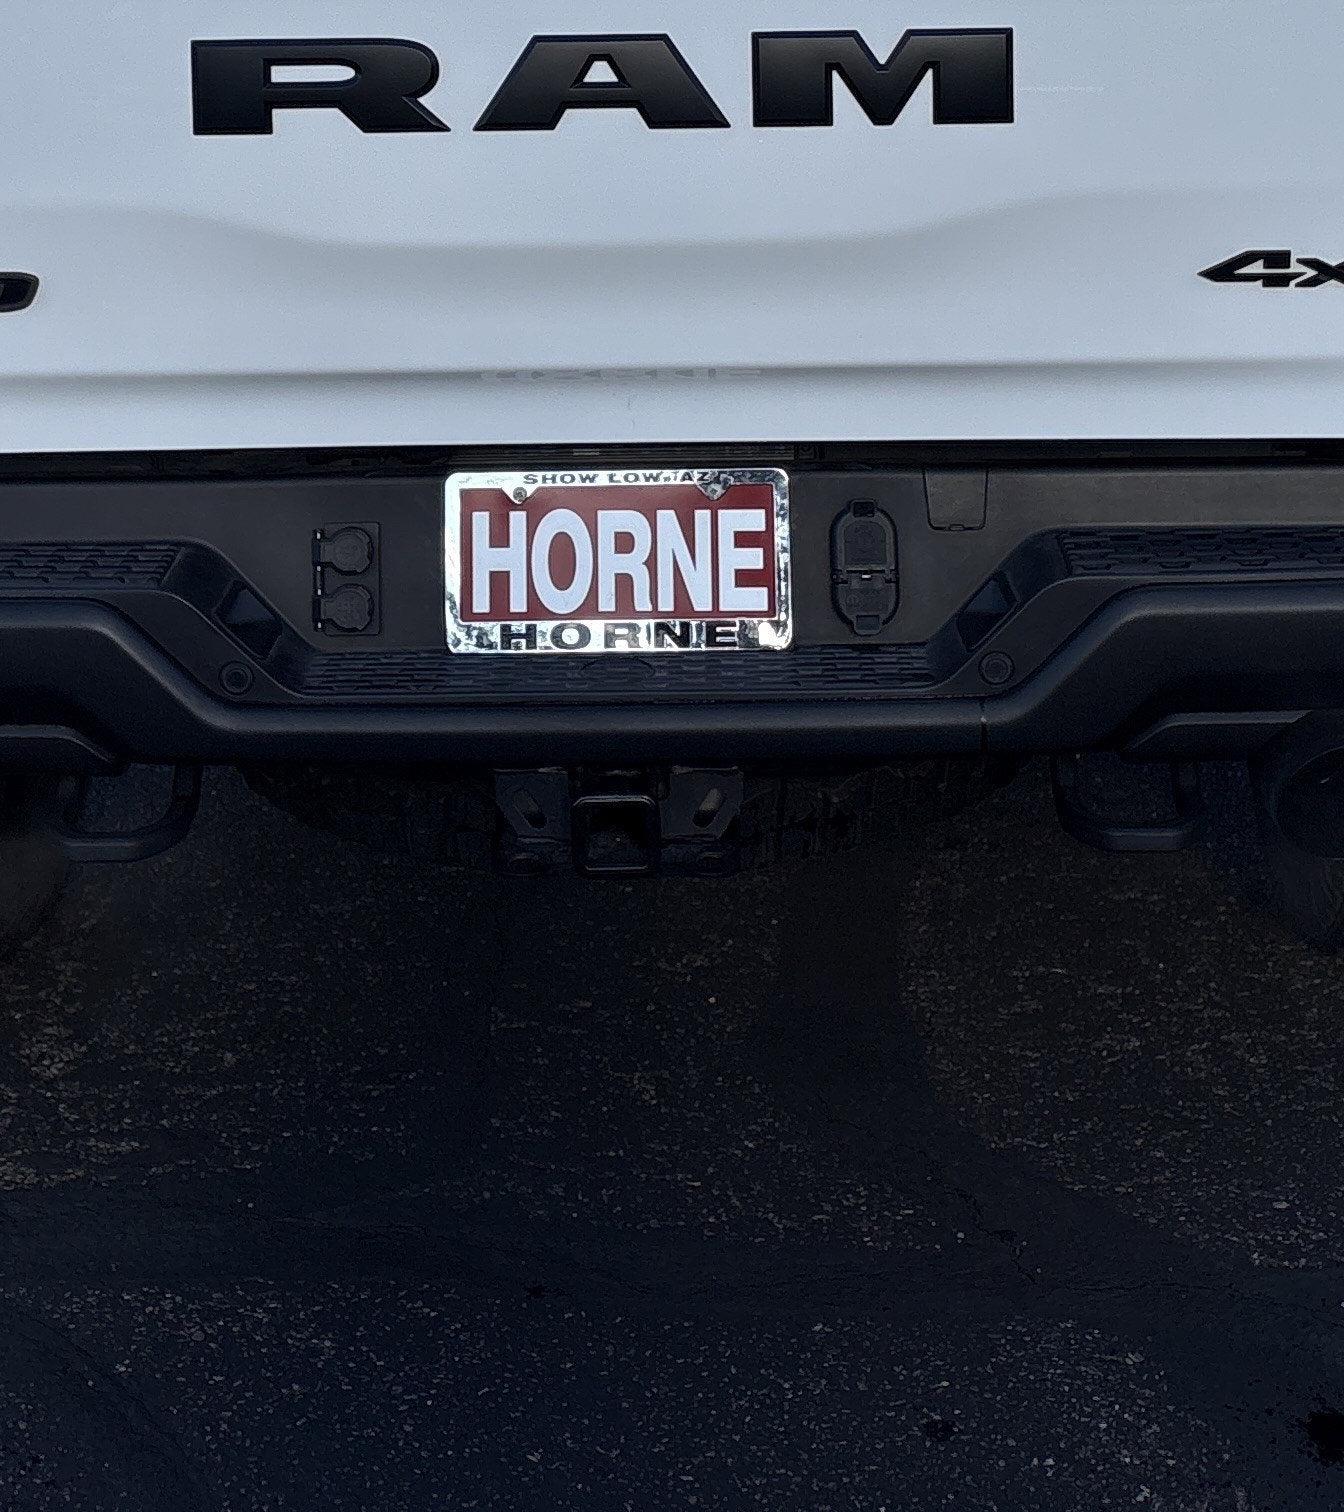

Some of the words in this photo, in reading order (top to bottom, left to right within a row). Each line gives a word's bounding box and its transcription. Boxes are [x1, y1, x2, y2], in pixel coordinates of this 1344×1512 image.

[191, 28, 1014, 134] RAM
[523, 473, 599, 485] SHOW
[680, 470, 710, 483] AZ
[472, 508, 769, 614] HORNE
[500, 622, 740, 650] HORNE
